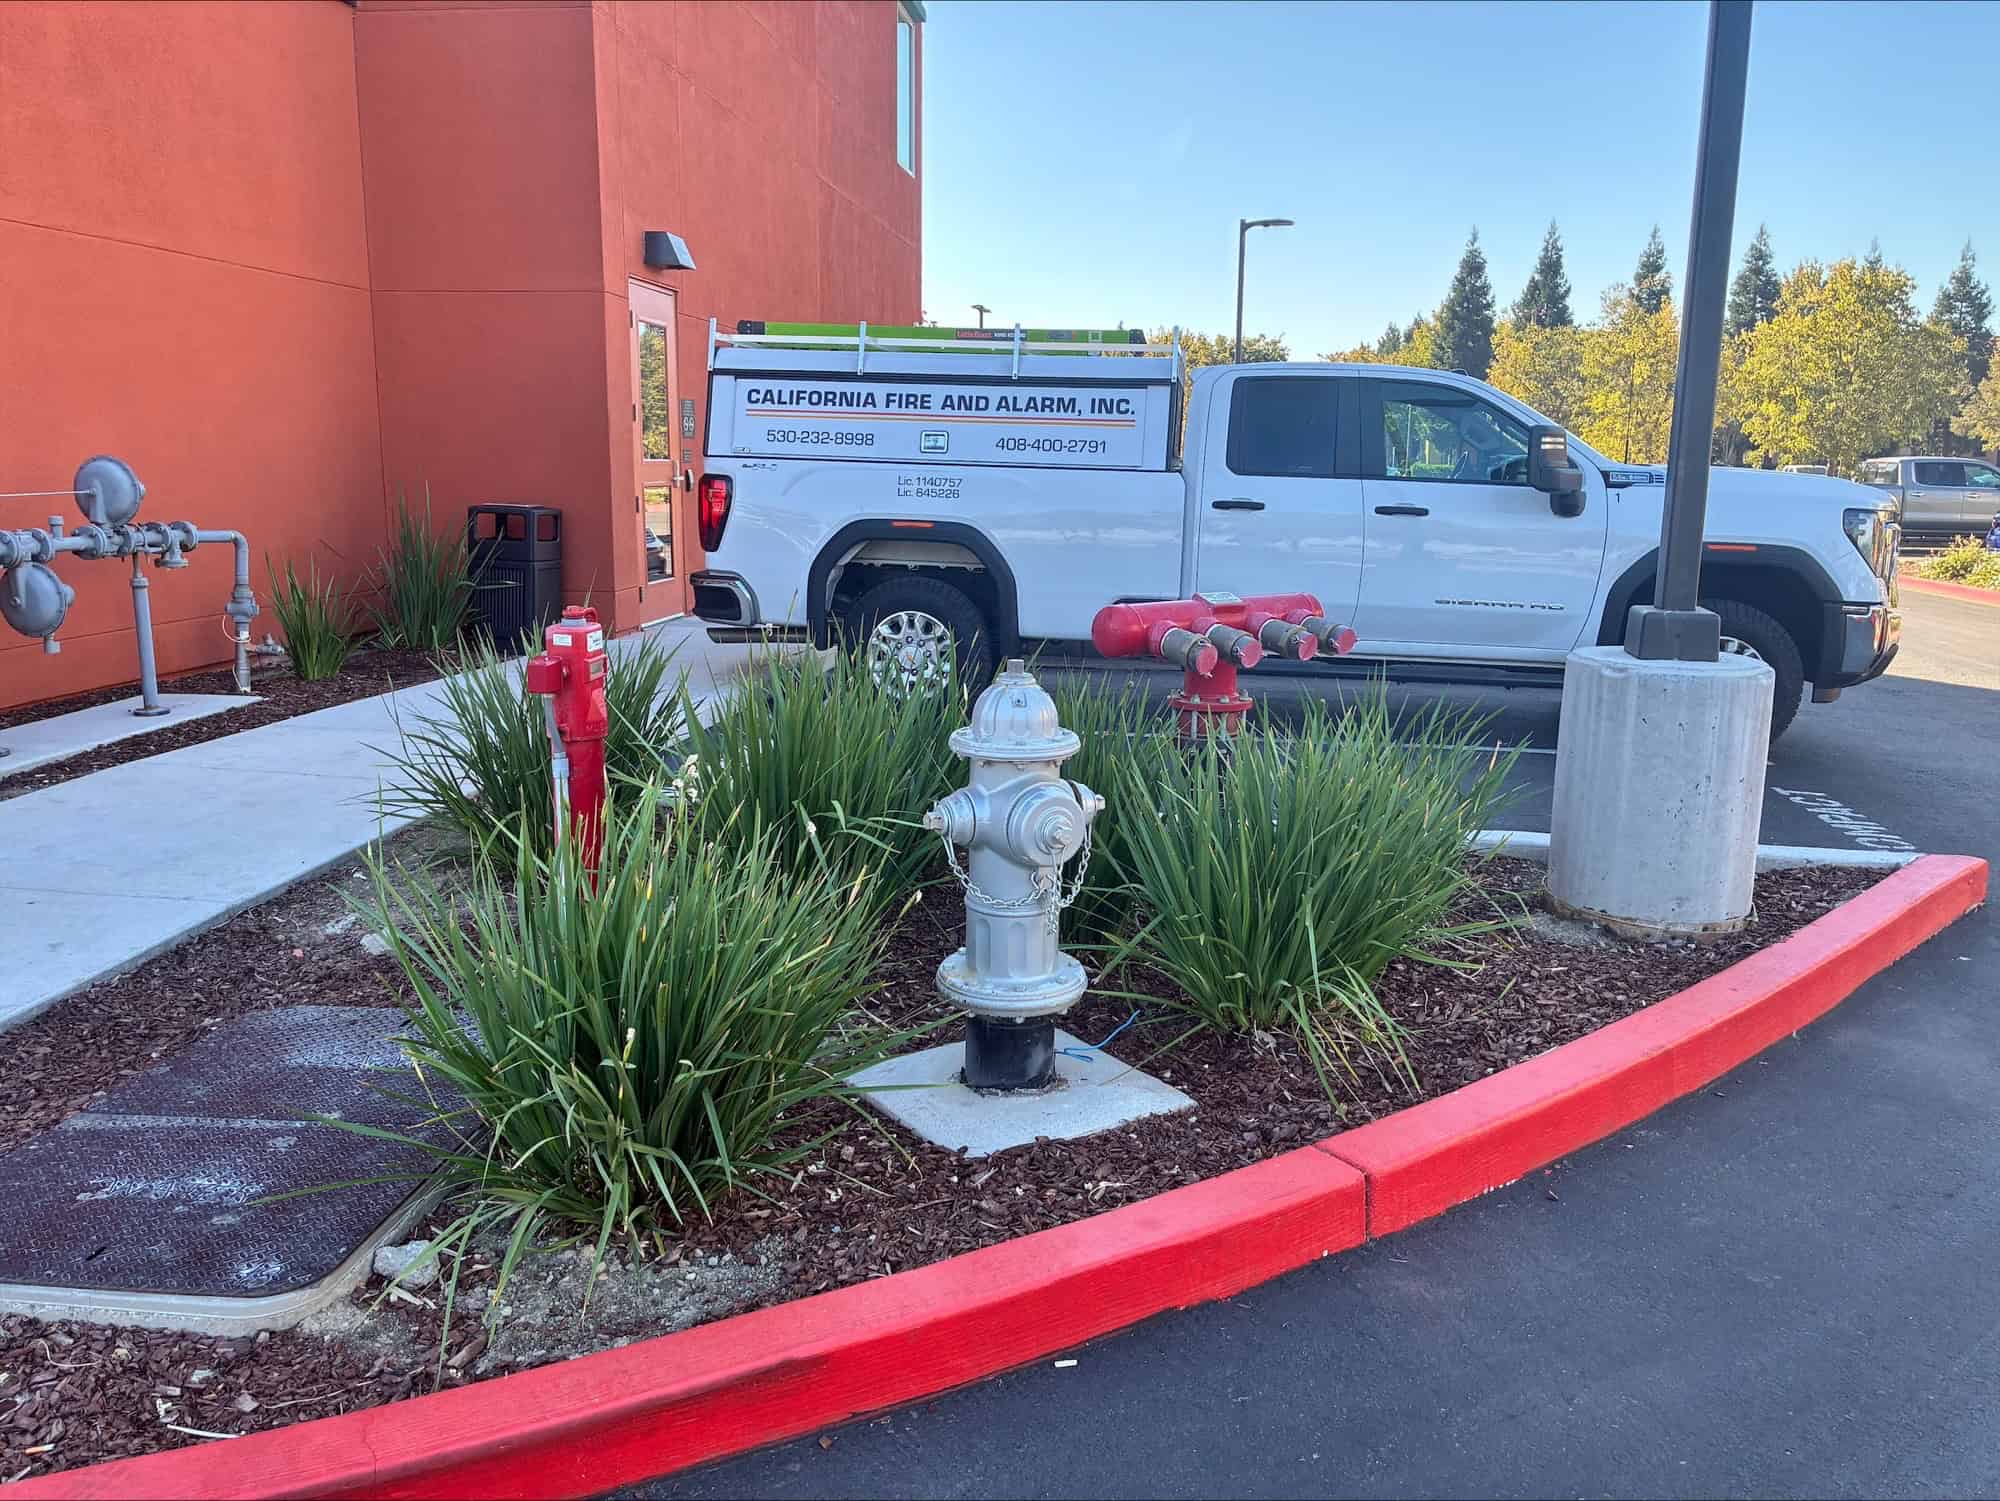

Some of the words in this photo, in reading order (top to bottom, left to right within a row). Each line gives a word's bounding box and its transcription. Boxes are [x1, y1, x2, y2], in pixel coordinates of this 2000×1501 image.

[747, 388, 877, 408] CALIFORNIA
[885, 393, 932, 410] FIRE
[941, 395, 990, 412] AND
[995, 395, 1082, 417] ALARM,
[1090, 397, 1136, 416] INC.
[766, 429, 875, 447] 530-232-8998
[995, 436, 1107, 454] 408-400-2791
